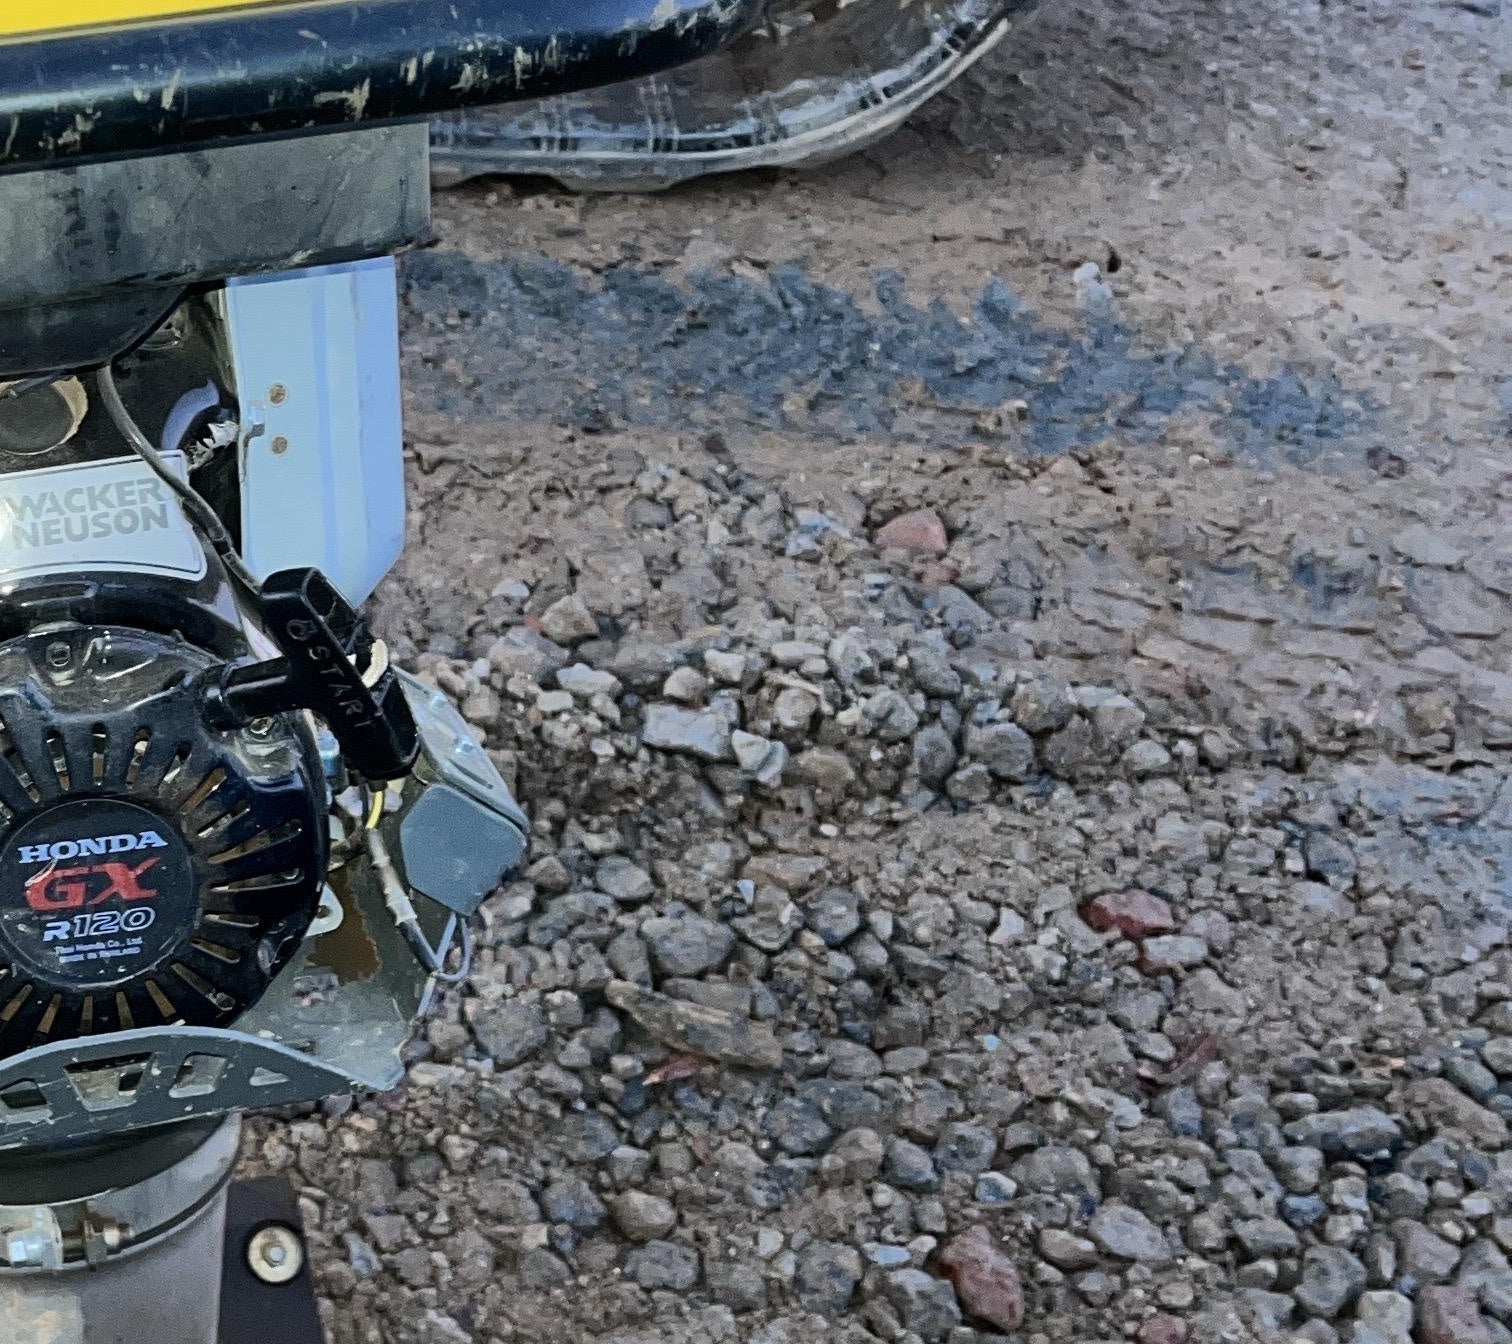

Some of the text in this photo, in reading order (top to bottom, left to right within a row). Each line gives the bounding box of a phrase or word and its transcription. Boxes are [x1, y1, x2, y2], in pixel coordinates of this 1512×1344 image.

[1, 476, 168, 524] WACKER
[10, 503, 171, 551] NEUSON
[17, 829, 169, 864] HONDA
[24, 856, 161, 911] GX
[42, 906, 156, 942] R120
